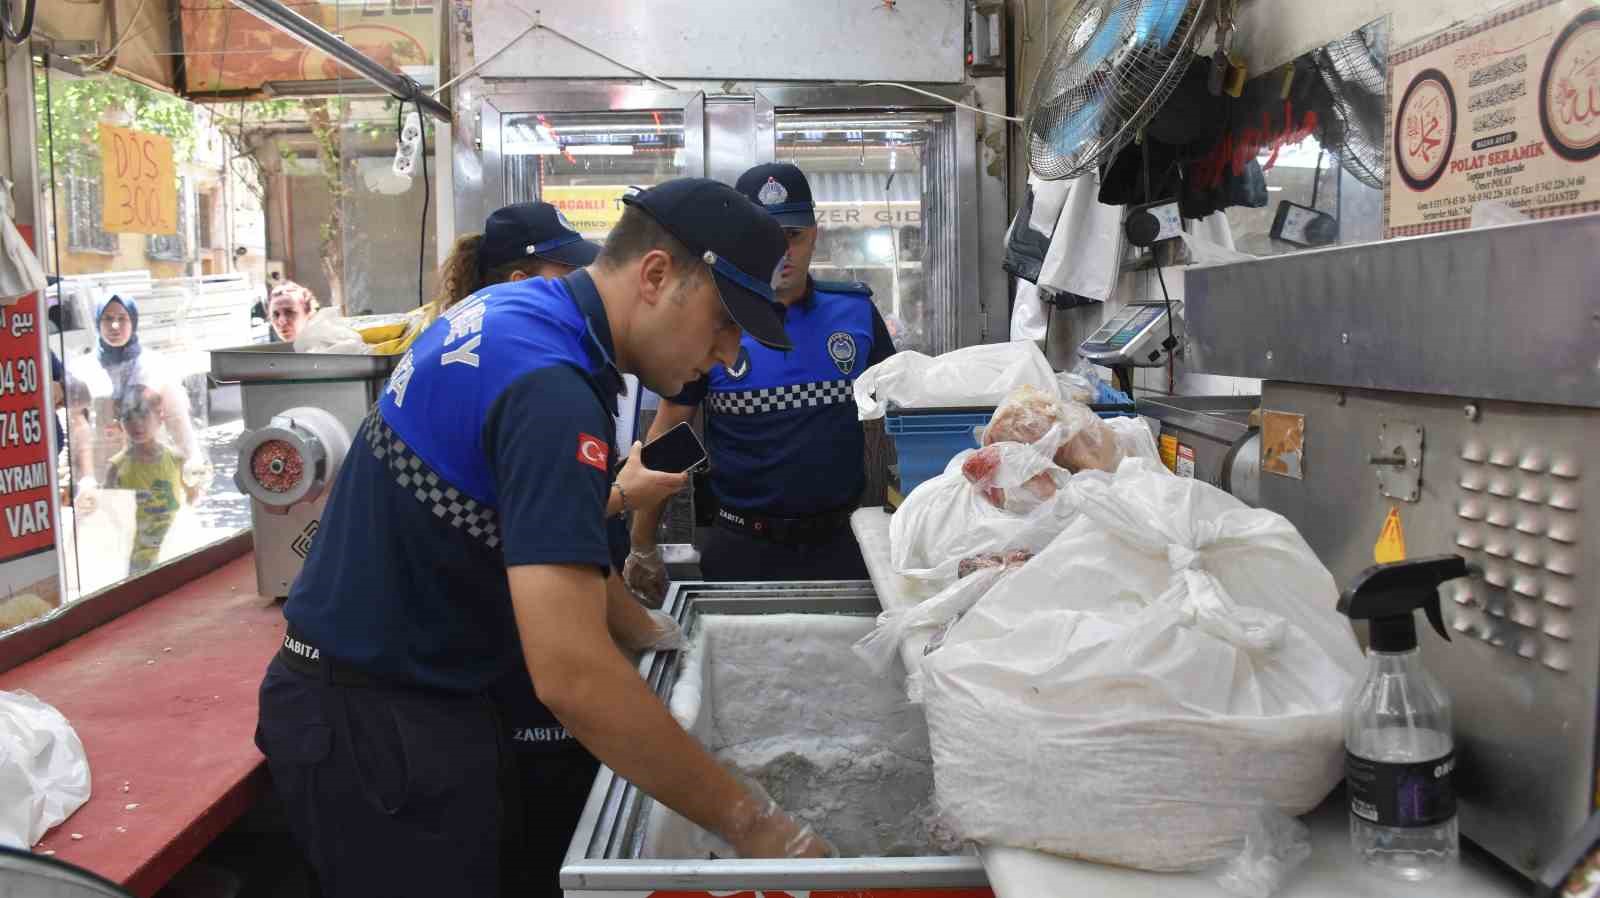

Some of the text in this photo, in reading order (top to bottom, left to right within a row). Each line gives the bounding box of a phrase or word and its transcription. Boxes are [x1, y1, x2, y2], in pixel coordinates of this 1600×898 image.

[1450, 141, 1545, 174] POLAT SERAMİK
[18, 358, 38, 393] 30
[22, 410, 41, 444] 65
[5, 499, 51, 538] VAR
[720, 508, 745, 526] ZABITA
[285, 635, 321, 660] ZABITA
